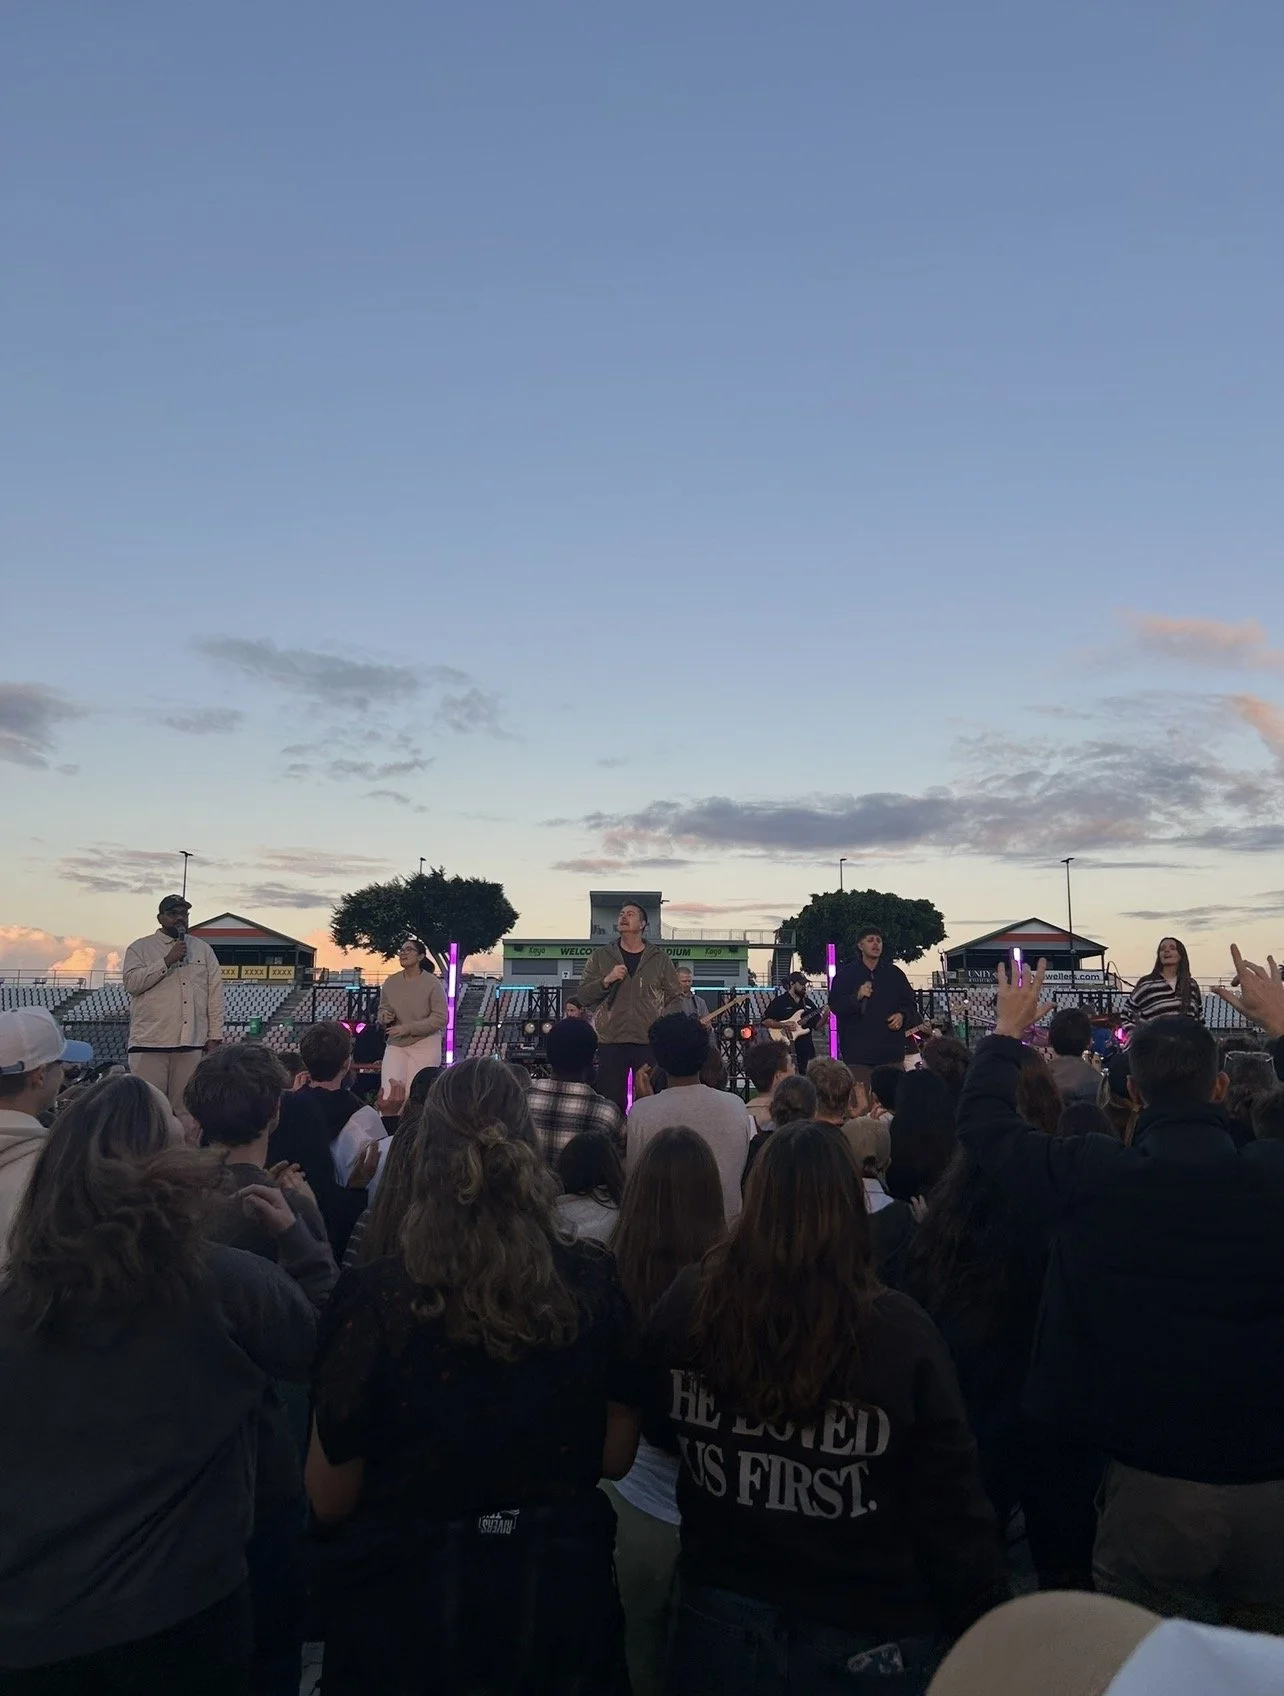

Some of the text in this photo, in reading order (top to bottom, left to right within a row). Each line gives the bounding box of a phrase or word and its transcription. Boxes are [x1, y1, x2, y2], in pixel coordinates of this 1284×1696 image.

[669, 1369, 721, 1429] HE
[677, 1434, 877, 1519] US FIRST.
